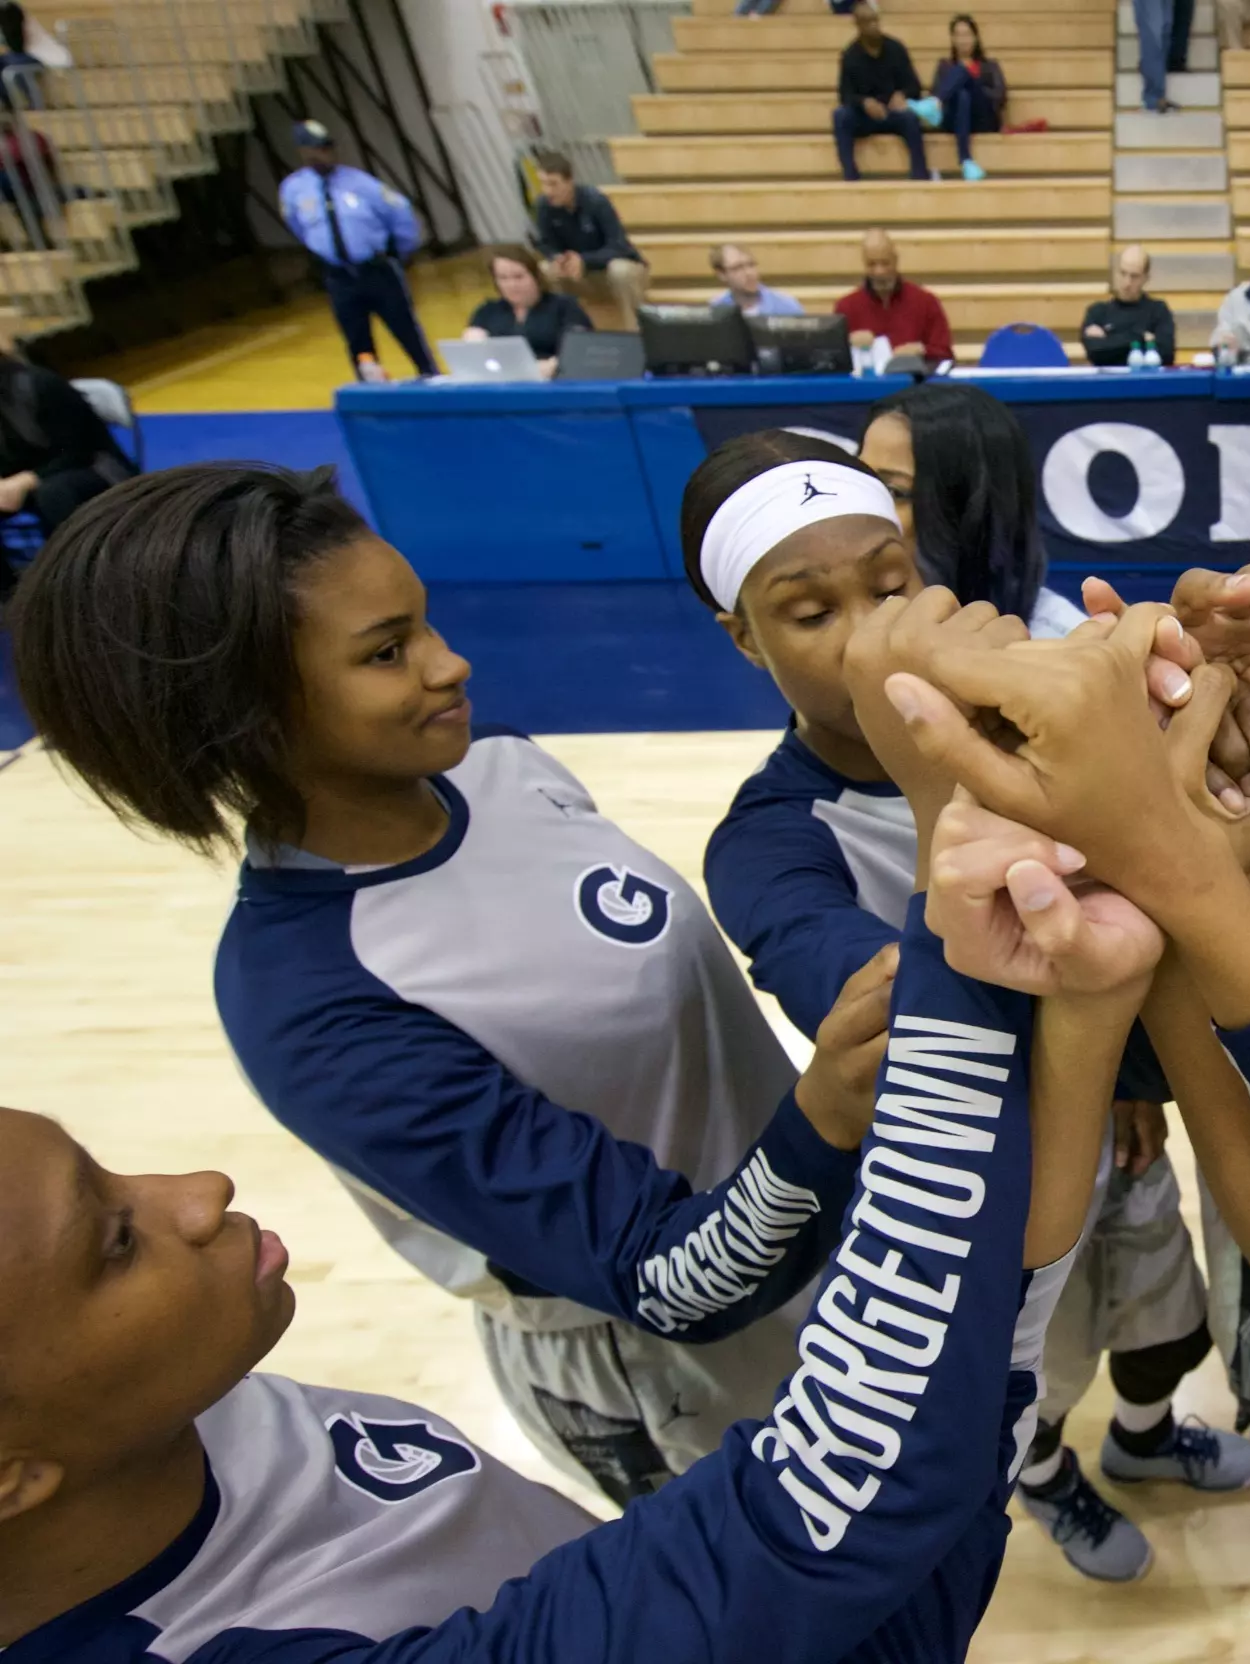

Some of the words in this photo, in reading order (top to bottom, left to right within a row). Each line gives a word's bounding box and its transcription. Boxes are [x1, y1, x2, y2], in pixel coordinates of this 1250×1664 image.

[573, 862, 676, 950] G
[637, 1147, 821, 1333] GORGETOWN
[752, 1014, 1017, 1552] GEORGETOWN
